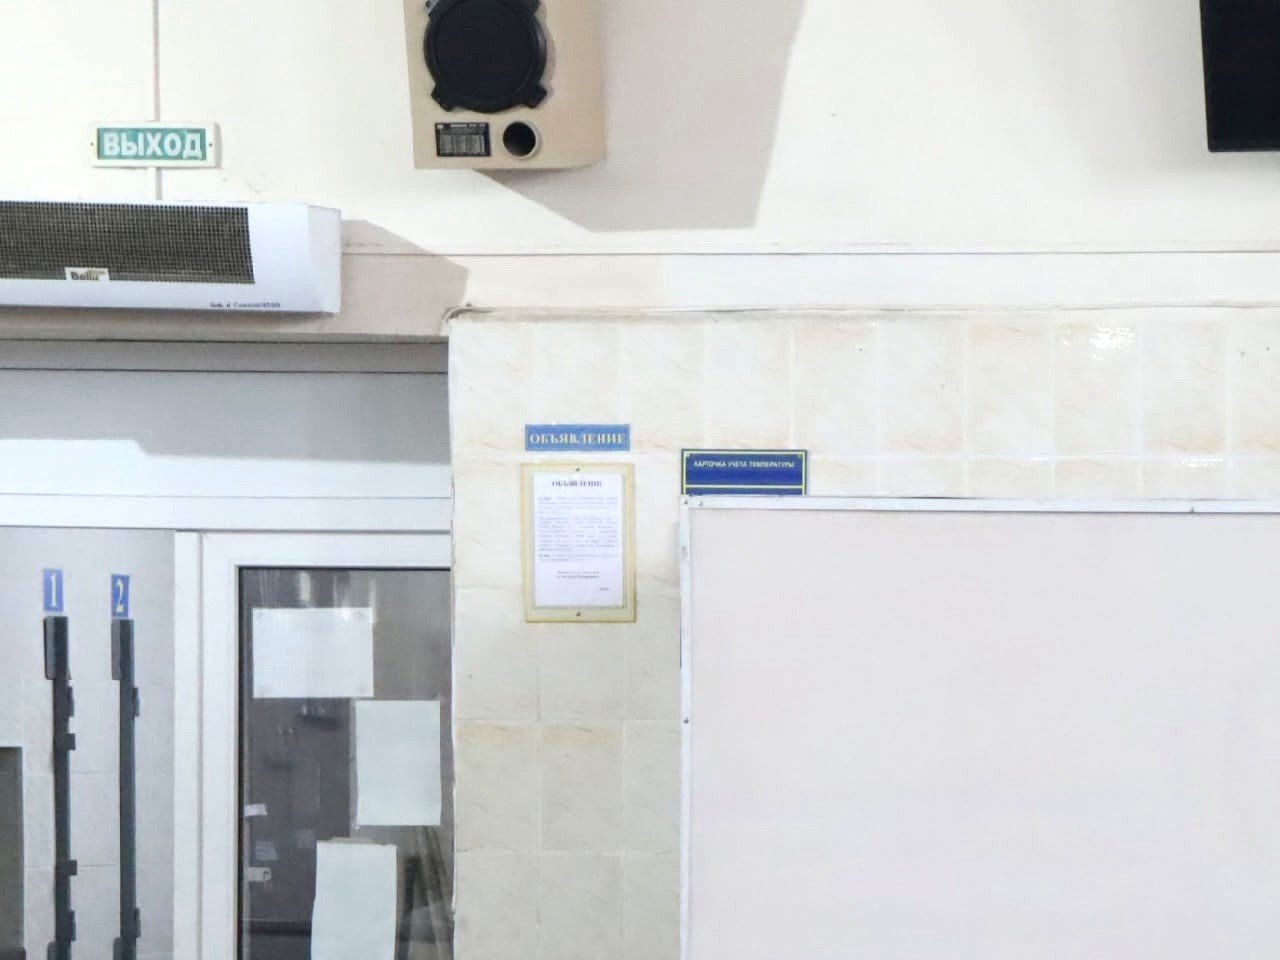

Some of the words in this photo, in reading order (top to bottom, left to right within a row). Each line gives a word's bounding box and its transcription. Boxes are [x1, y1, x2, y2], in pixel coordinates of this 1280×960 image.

[103, 132, 202, 159] ВЫХОД
[529, 432, 626, 445] ОБЪЯВЛЕНИЕ
[50, 574, 57, 607] 1
[115, 578, 124, 612] 2
